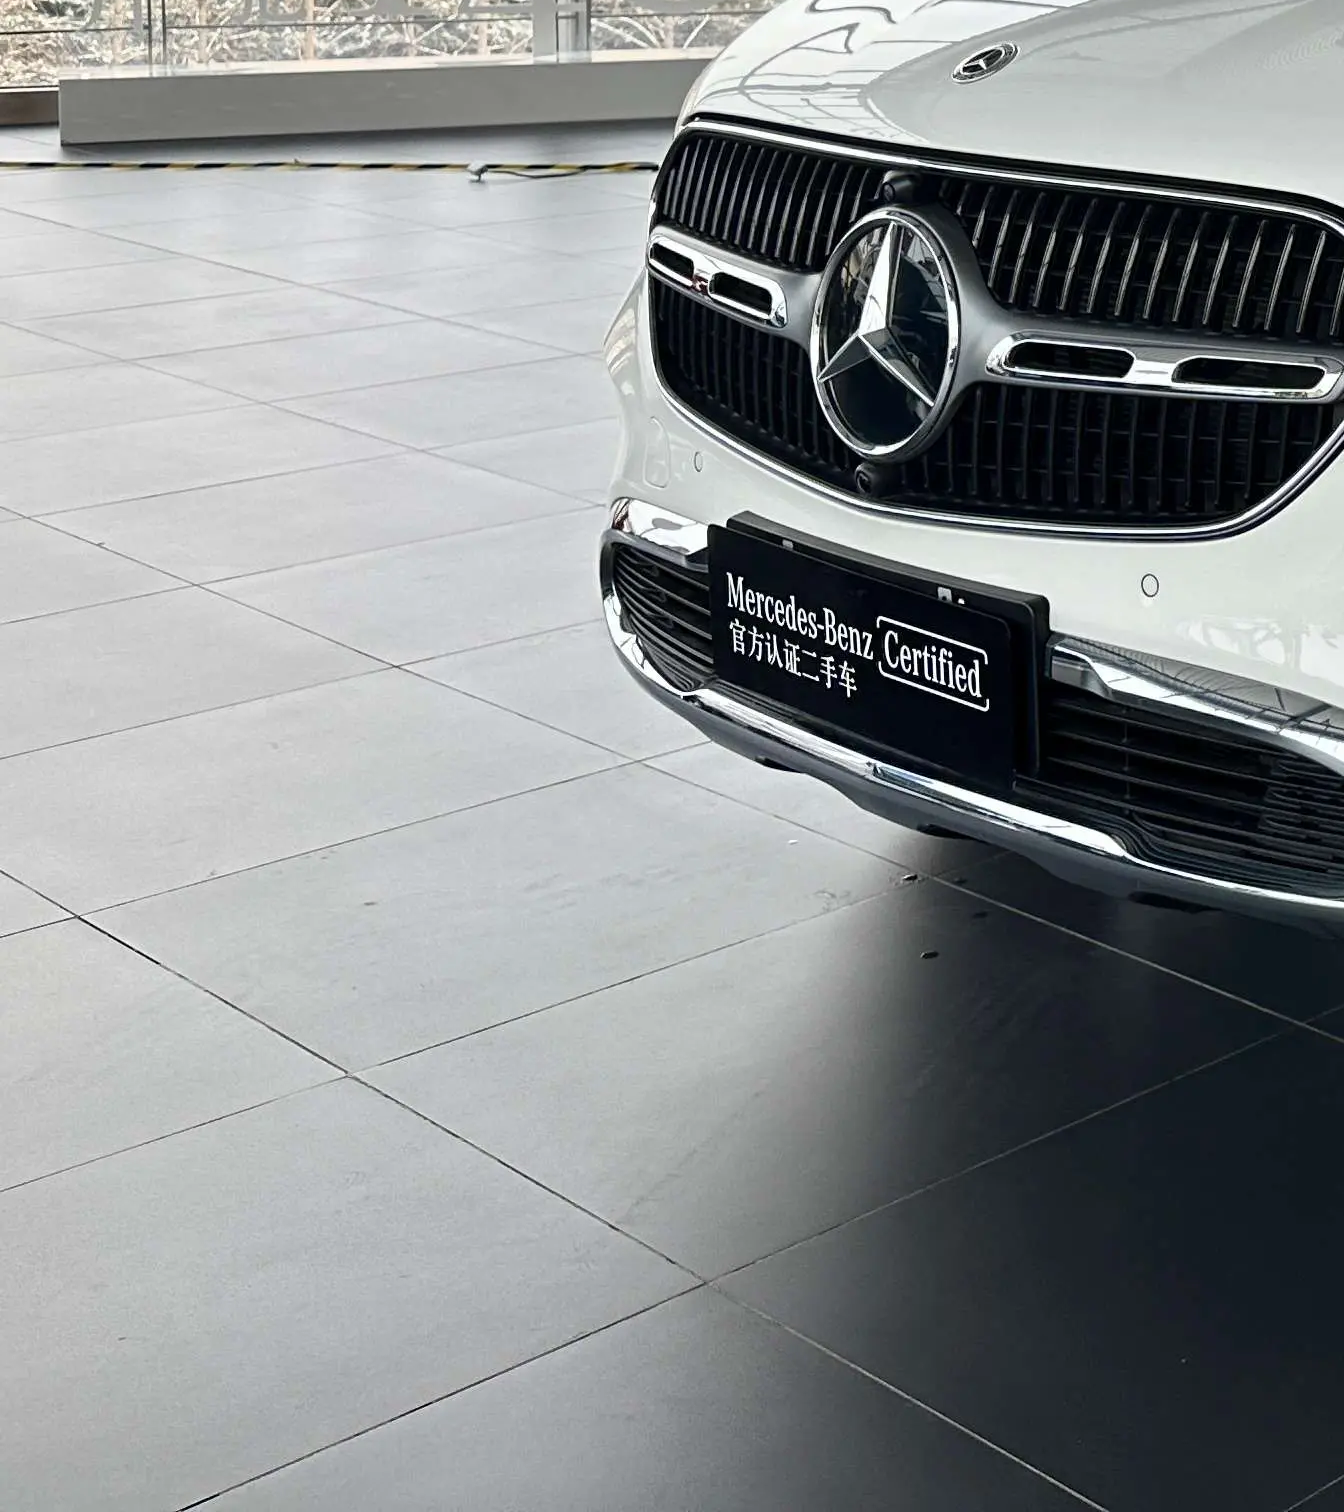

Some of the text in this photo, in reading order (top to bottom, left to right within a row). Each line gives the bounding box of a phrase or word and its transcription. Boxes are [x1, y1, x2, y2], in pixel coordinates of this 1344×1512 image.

[725, 571, 983, 699] Mercedes-Benz Certified
[728, 618, 858, 699] 官方认证二手车
